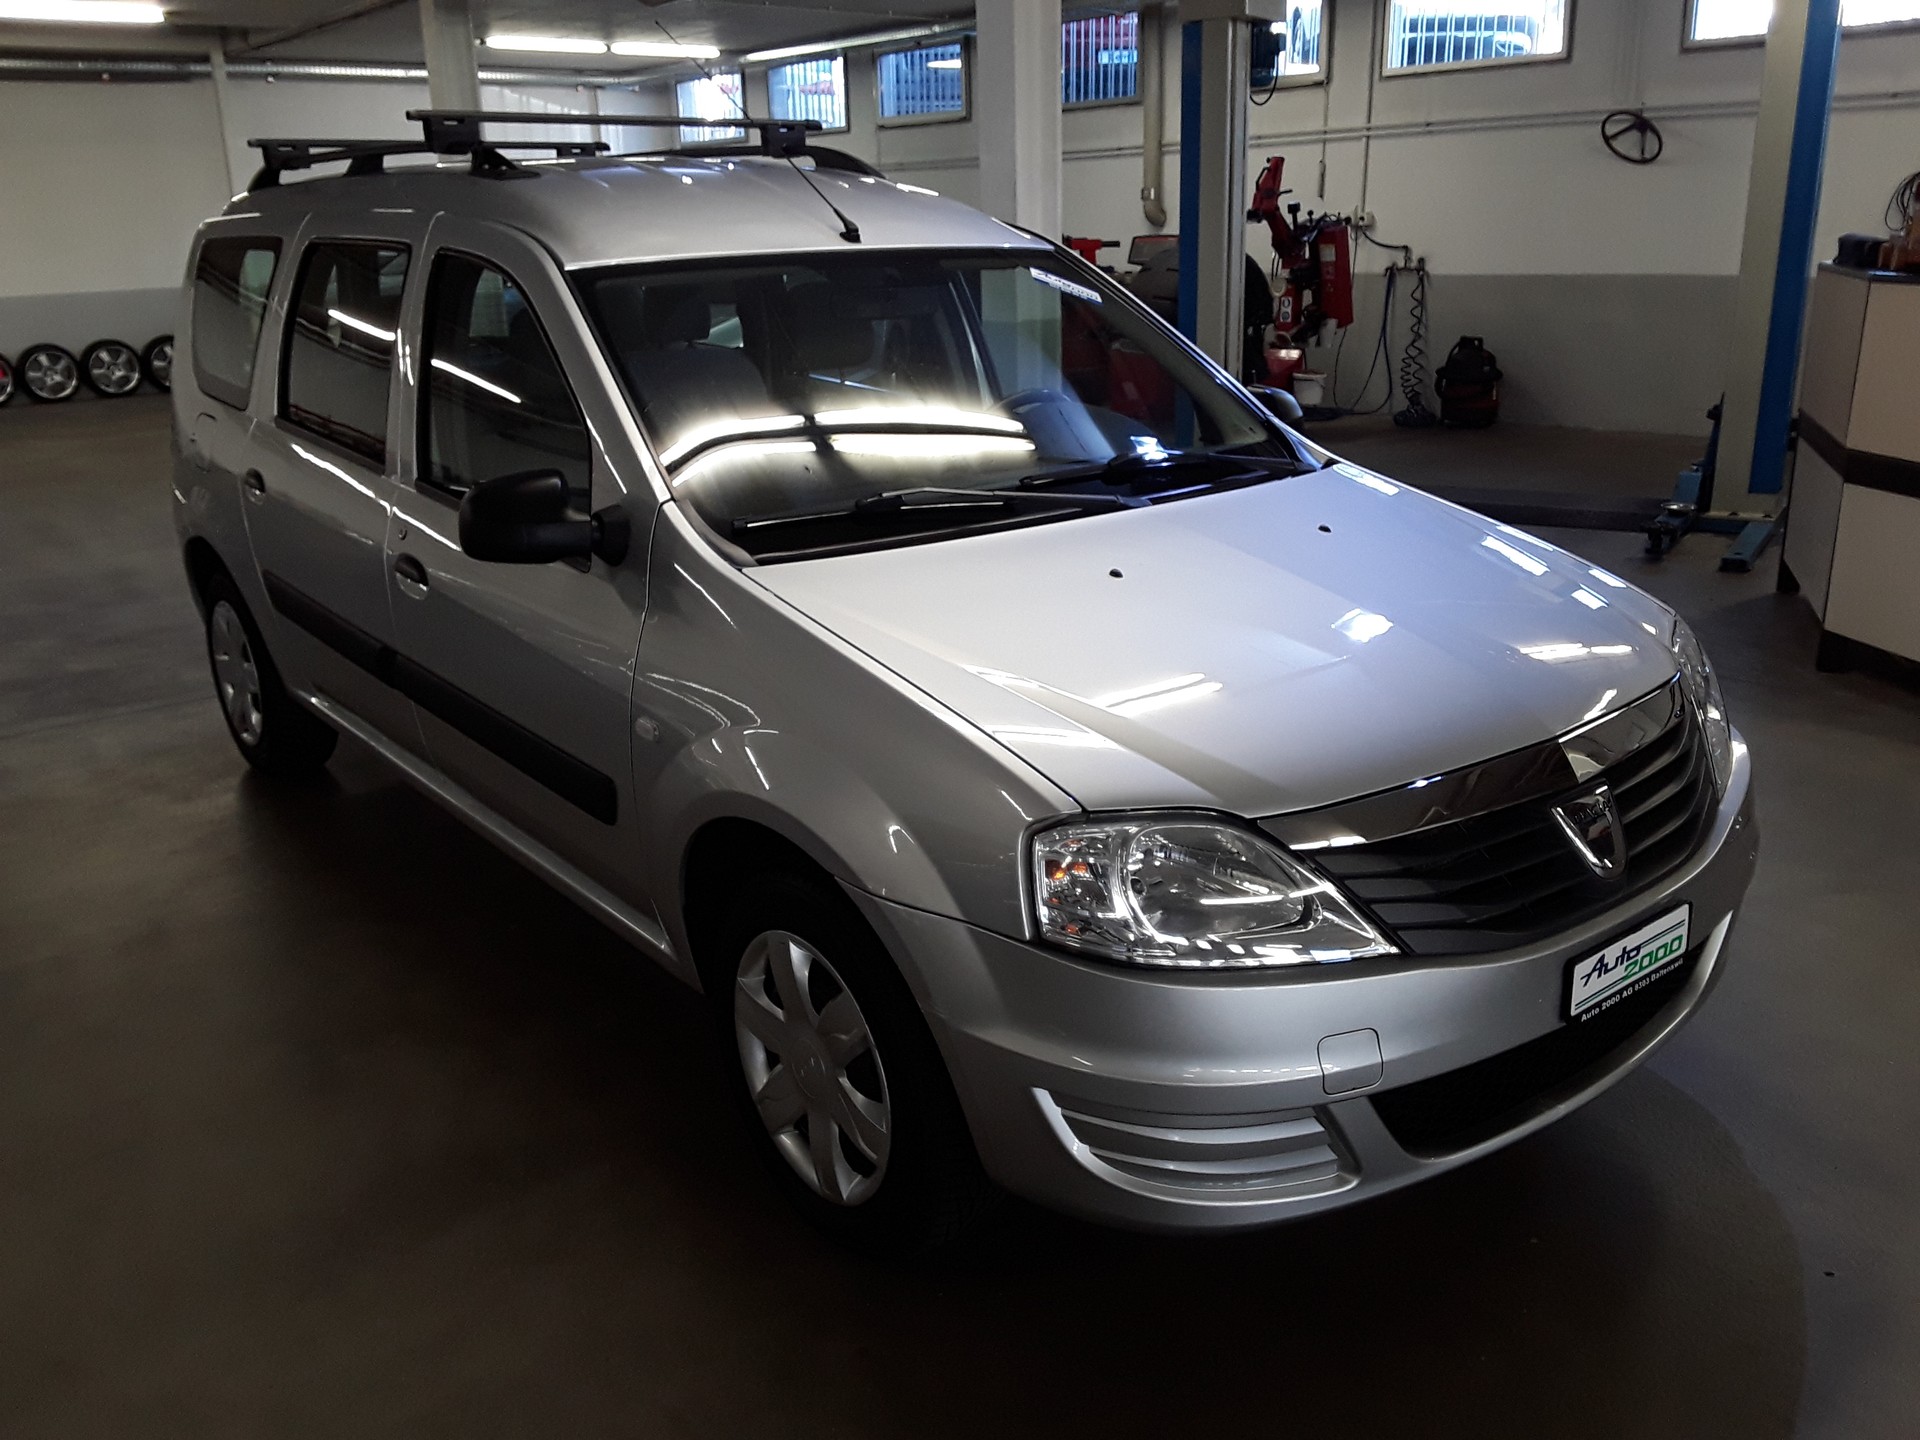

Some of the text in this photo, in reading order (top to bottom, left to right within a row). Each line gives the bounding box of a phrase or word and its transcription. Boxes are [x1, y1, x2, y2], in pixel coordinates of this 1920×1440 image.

[1580, 945, 1642, 988] Auto
[1623, 934, 1684, 981] 2000
[1581, 1006, 1600, 1022] Auto
[1601, 994, 1620, 1011] 2000
[1622, 987, 1633, 998] AG
